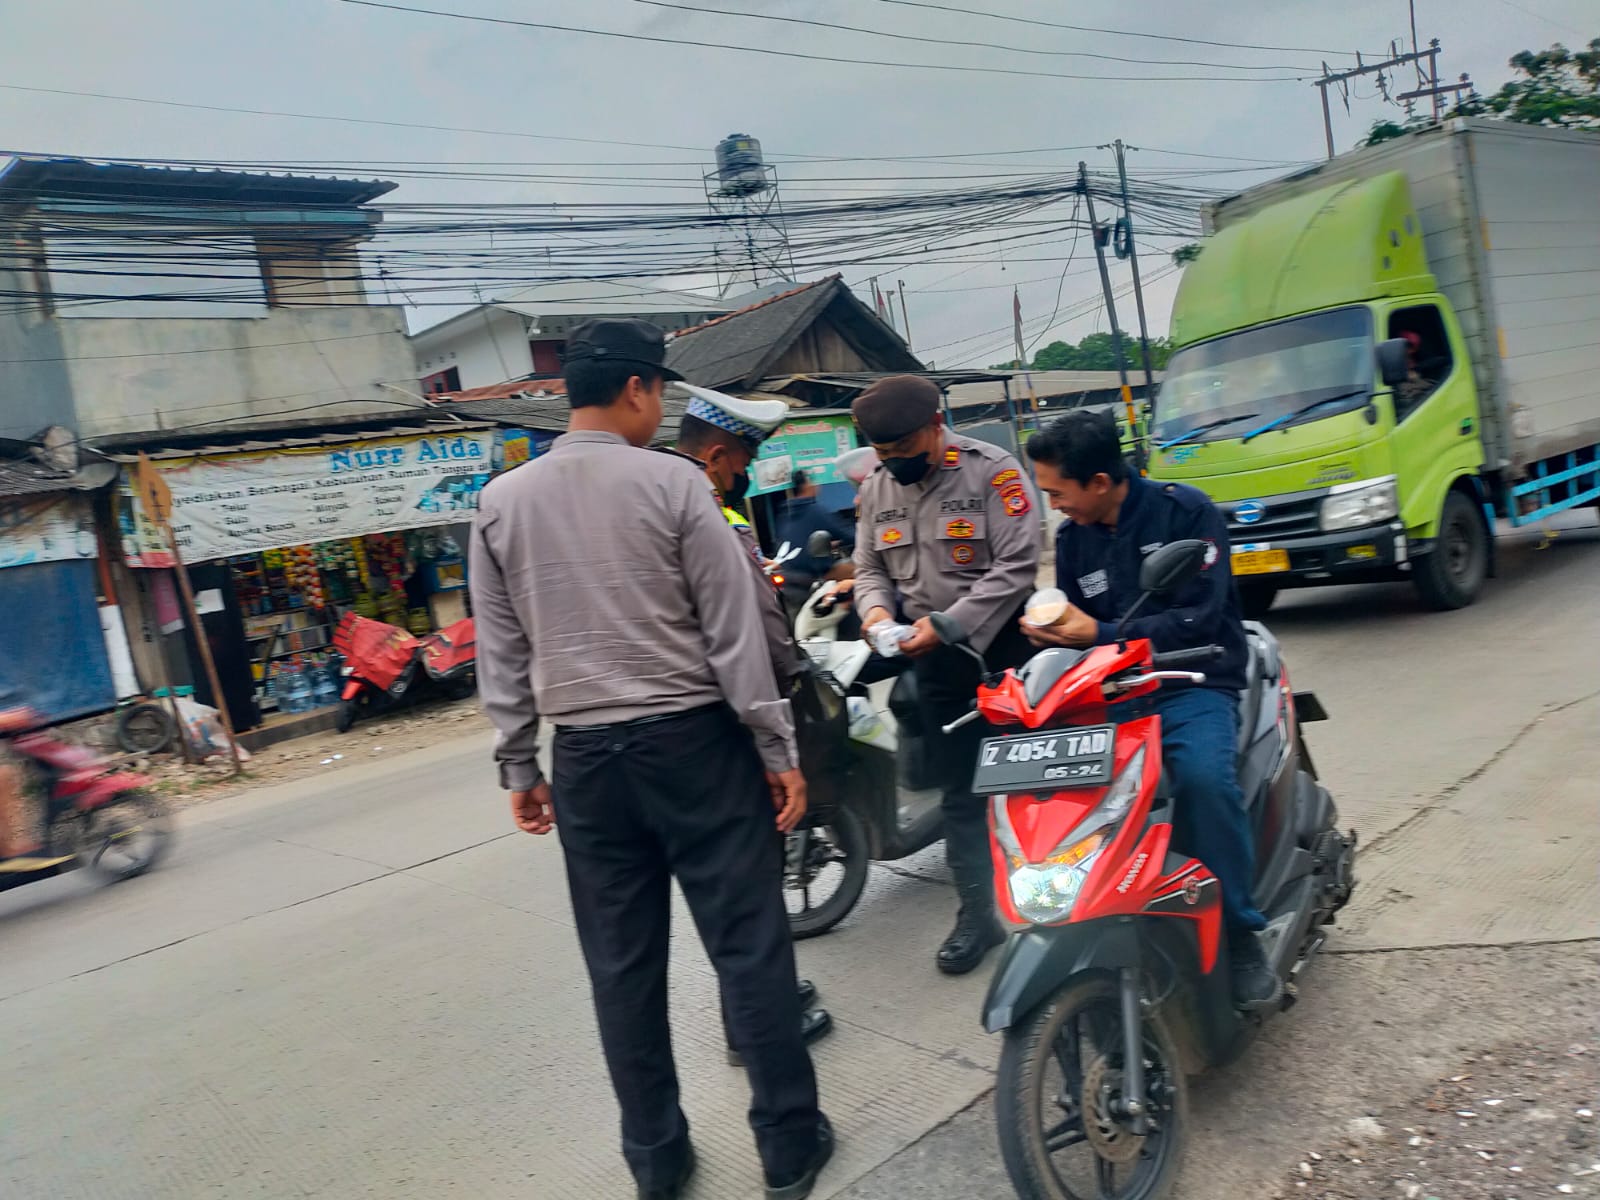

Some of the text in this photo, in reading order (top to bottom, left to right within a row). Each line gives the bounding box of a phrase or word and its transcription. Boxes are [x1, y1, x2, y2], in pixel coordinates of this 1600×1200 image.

[331, 448, 403, 471] Nurr
[417, 437, 481, 461] Aida
[248, 481, 307, 496] Berbagai
[387, 467, 430, 479] Rumah
[432, 465, 474, 476] Tangga
[940, 499, 983, 512] POLRI
[983, 747, 999, 766] Z
[1006, 739, 1058, 763] 4054
